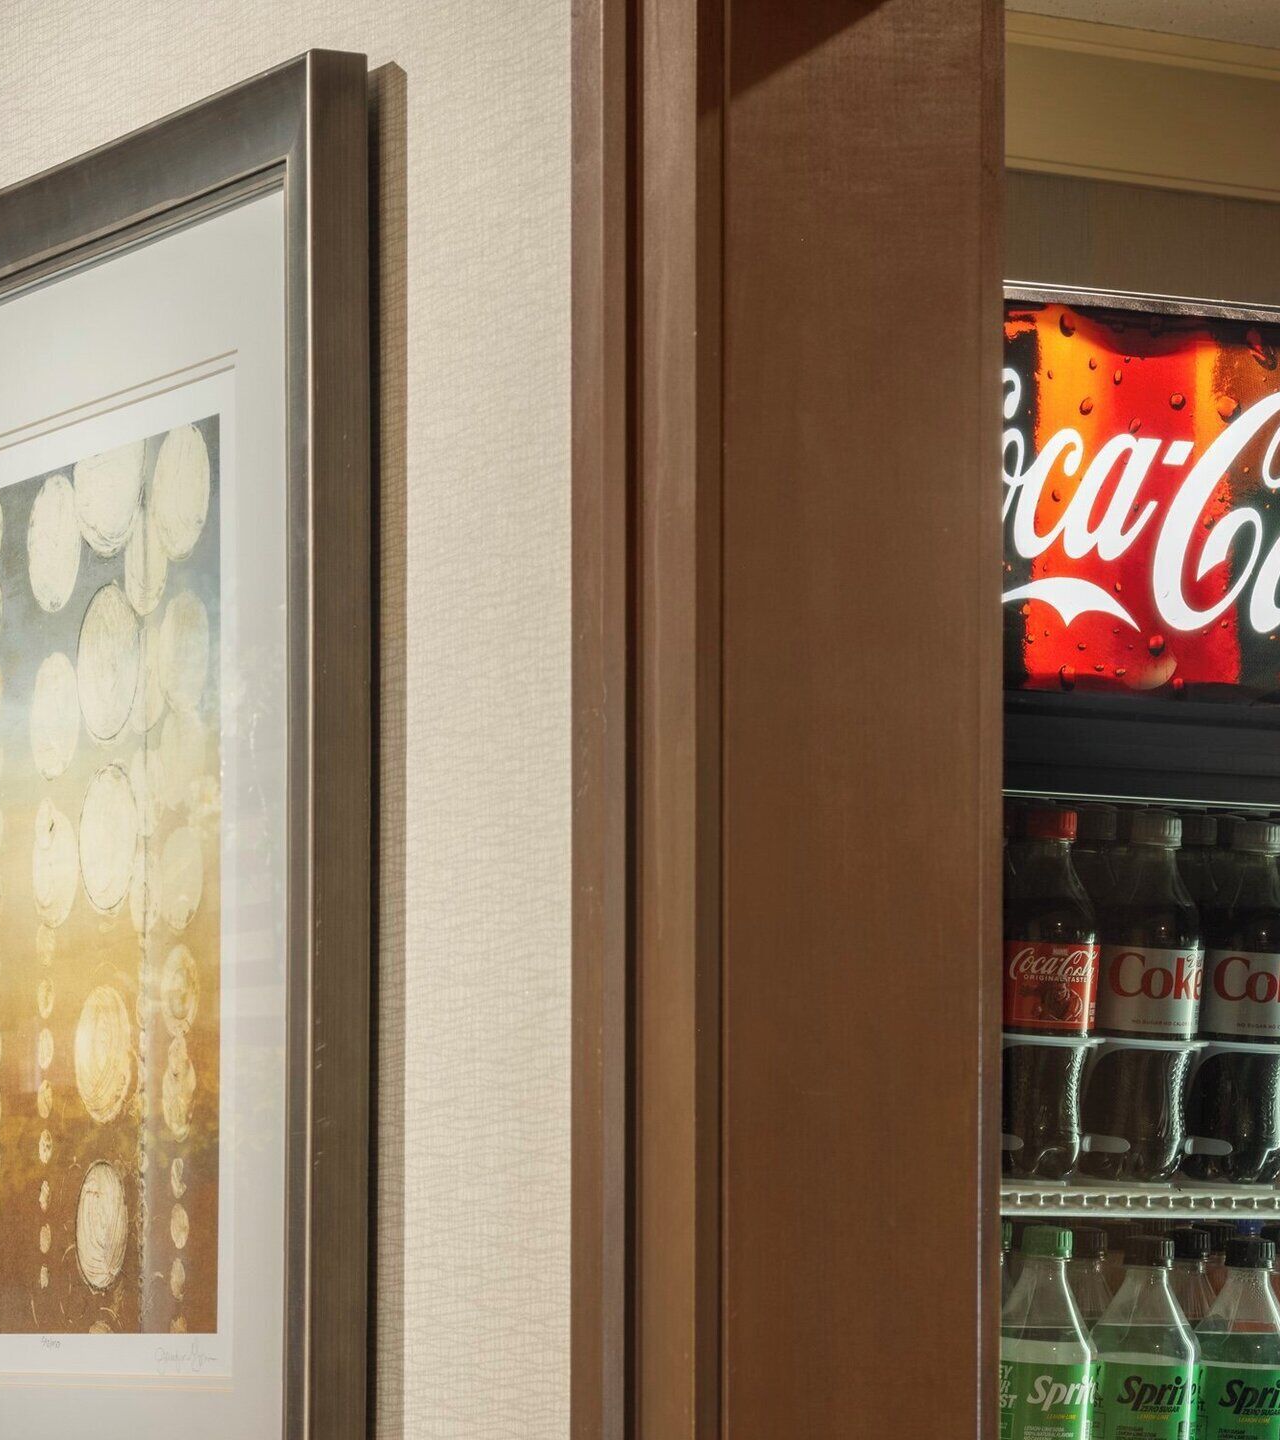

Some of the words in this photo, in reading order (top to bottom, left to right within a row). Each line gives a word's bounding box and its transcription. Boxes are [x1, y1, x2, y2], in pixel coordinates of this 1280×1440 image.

[1009, 947, 1099, 980] Coca-Cola
[1023, 974, 1065, 983] ORIGINAL
[1109, 951, 1204, 1001] Coke
[1116, 1375, 1198, 1412] Sprite
